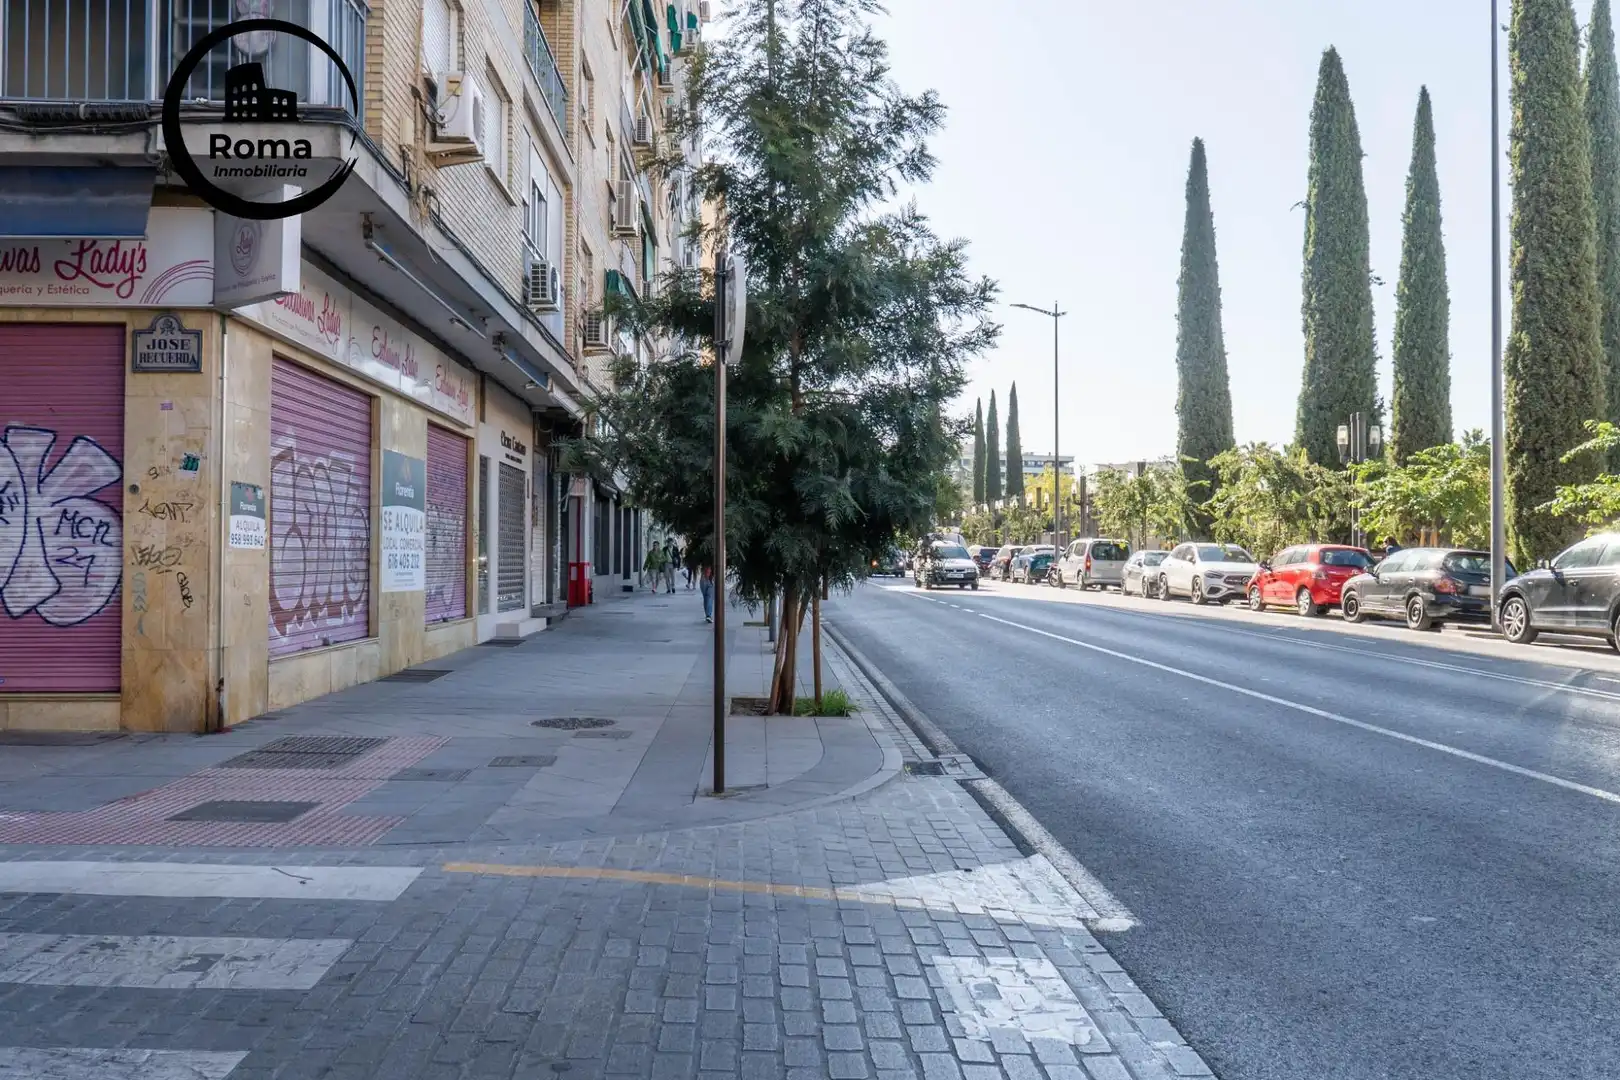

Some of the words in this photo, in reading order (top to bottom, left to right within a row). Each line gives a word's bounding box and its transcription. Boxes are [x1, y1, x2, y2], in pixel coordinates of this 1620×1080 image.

[54, 239, 147, 299] Lady's
[37, 286, 44, 297] y
[47, 283, 90, 296] Estética
[146, 338, 191, 351] JOSE
[138, 351, 198, 365] RECUERDA
[383, 510, 393, 531] SE
[394, 511, 425, 535] ALQUILA
[230, 532, 241, 545] 958
